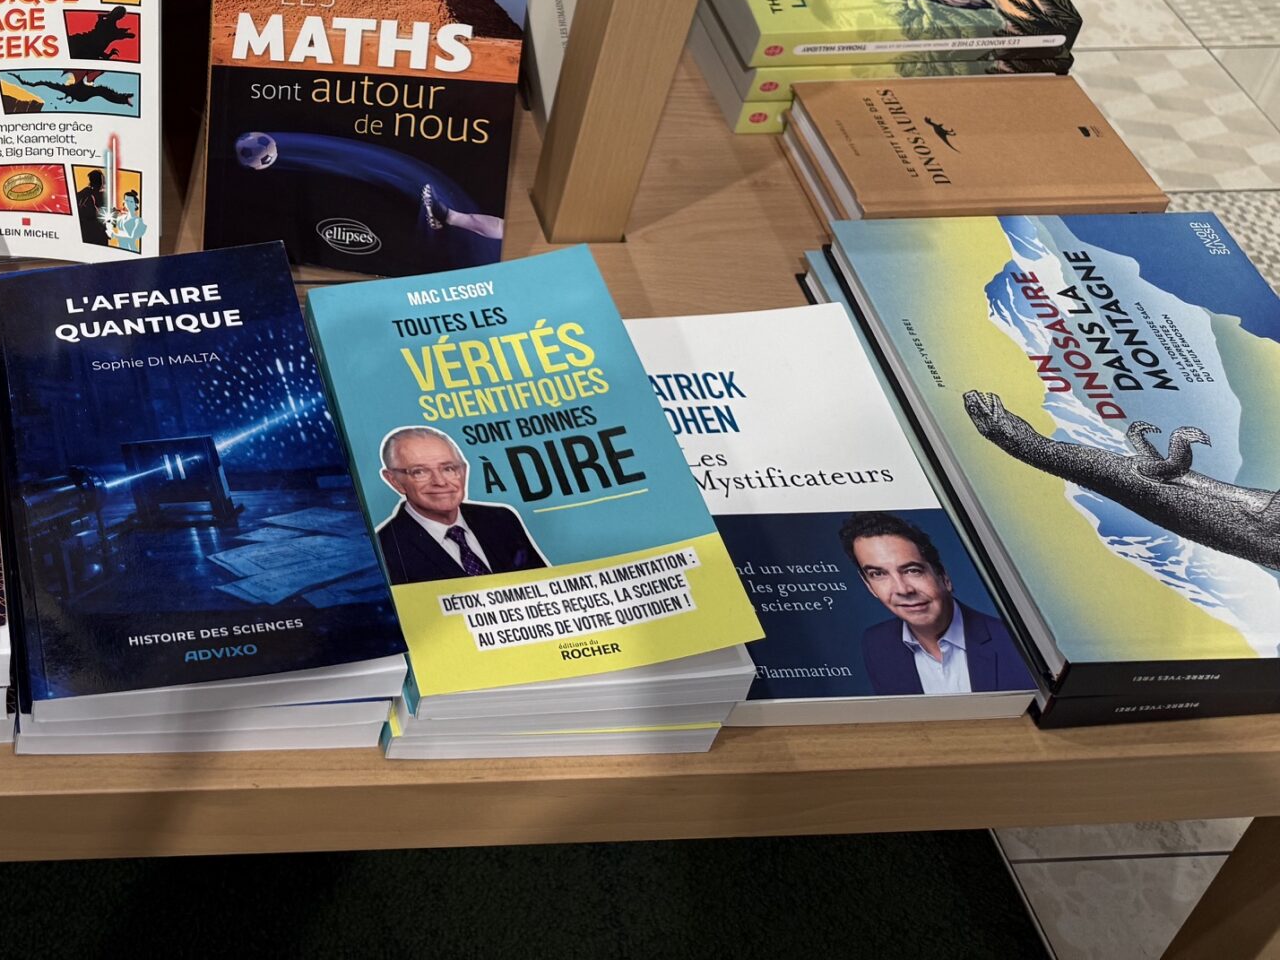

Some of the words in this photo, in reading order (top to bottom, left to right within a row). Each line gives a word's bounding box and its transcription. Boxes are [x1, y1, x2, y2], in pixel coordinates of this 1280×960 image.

[231, 12, 473, 73] MATHS
[250, 84, 302, 102] sont
[312, 76, 445, 110] autour
[354, 114, 383, 135] de
[394, 113, 489, 144] nous
[876, 88, 952, 185] DINOSAURES
[66, 284, 221, 313] L'AFFAIRE
[406, 288, 441, 306] MAC
[442, 280, 495, 300] LESGGY
[1057, 285, 1093, 315] LA
[54, 309, 242, 342] QUANTIQUE
[391, 312, 467, 338] TOUTES
[469, 306, 508, 329] LES
[1063, 250, 1180, 391] MONTAGNE
[400, 318, 596, 392] VÉRITÉS
[1010, 271, 1128, 420] DINOSAURE
[1078, 322, 1144, 391] DANS
[1028, 355, 1072, 393] UN
[418, 367, 610, 422] SCIENTIFIQUES
[462, 418, 517, 445] SONT
[520, 405, 597, 439] BONNES
[480, 455, 507, 494] À
[507, 425, 646, 502] DIRE
[692, 465, 894, 500] Mystificateurs
[184, 643, 257, 662] ADVIXO
[561, 643, 622, 661] ROCHER
